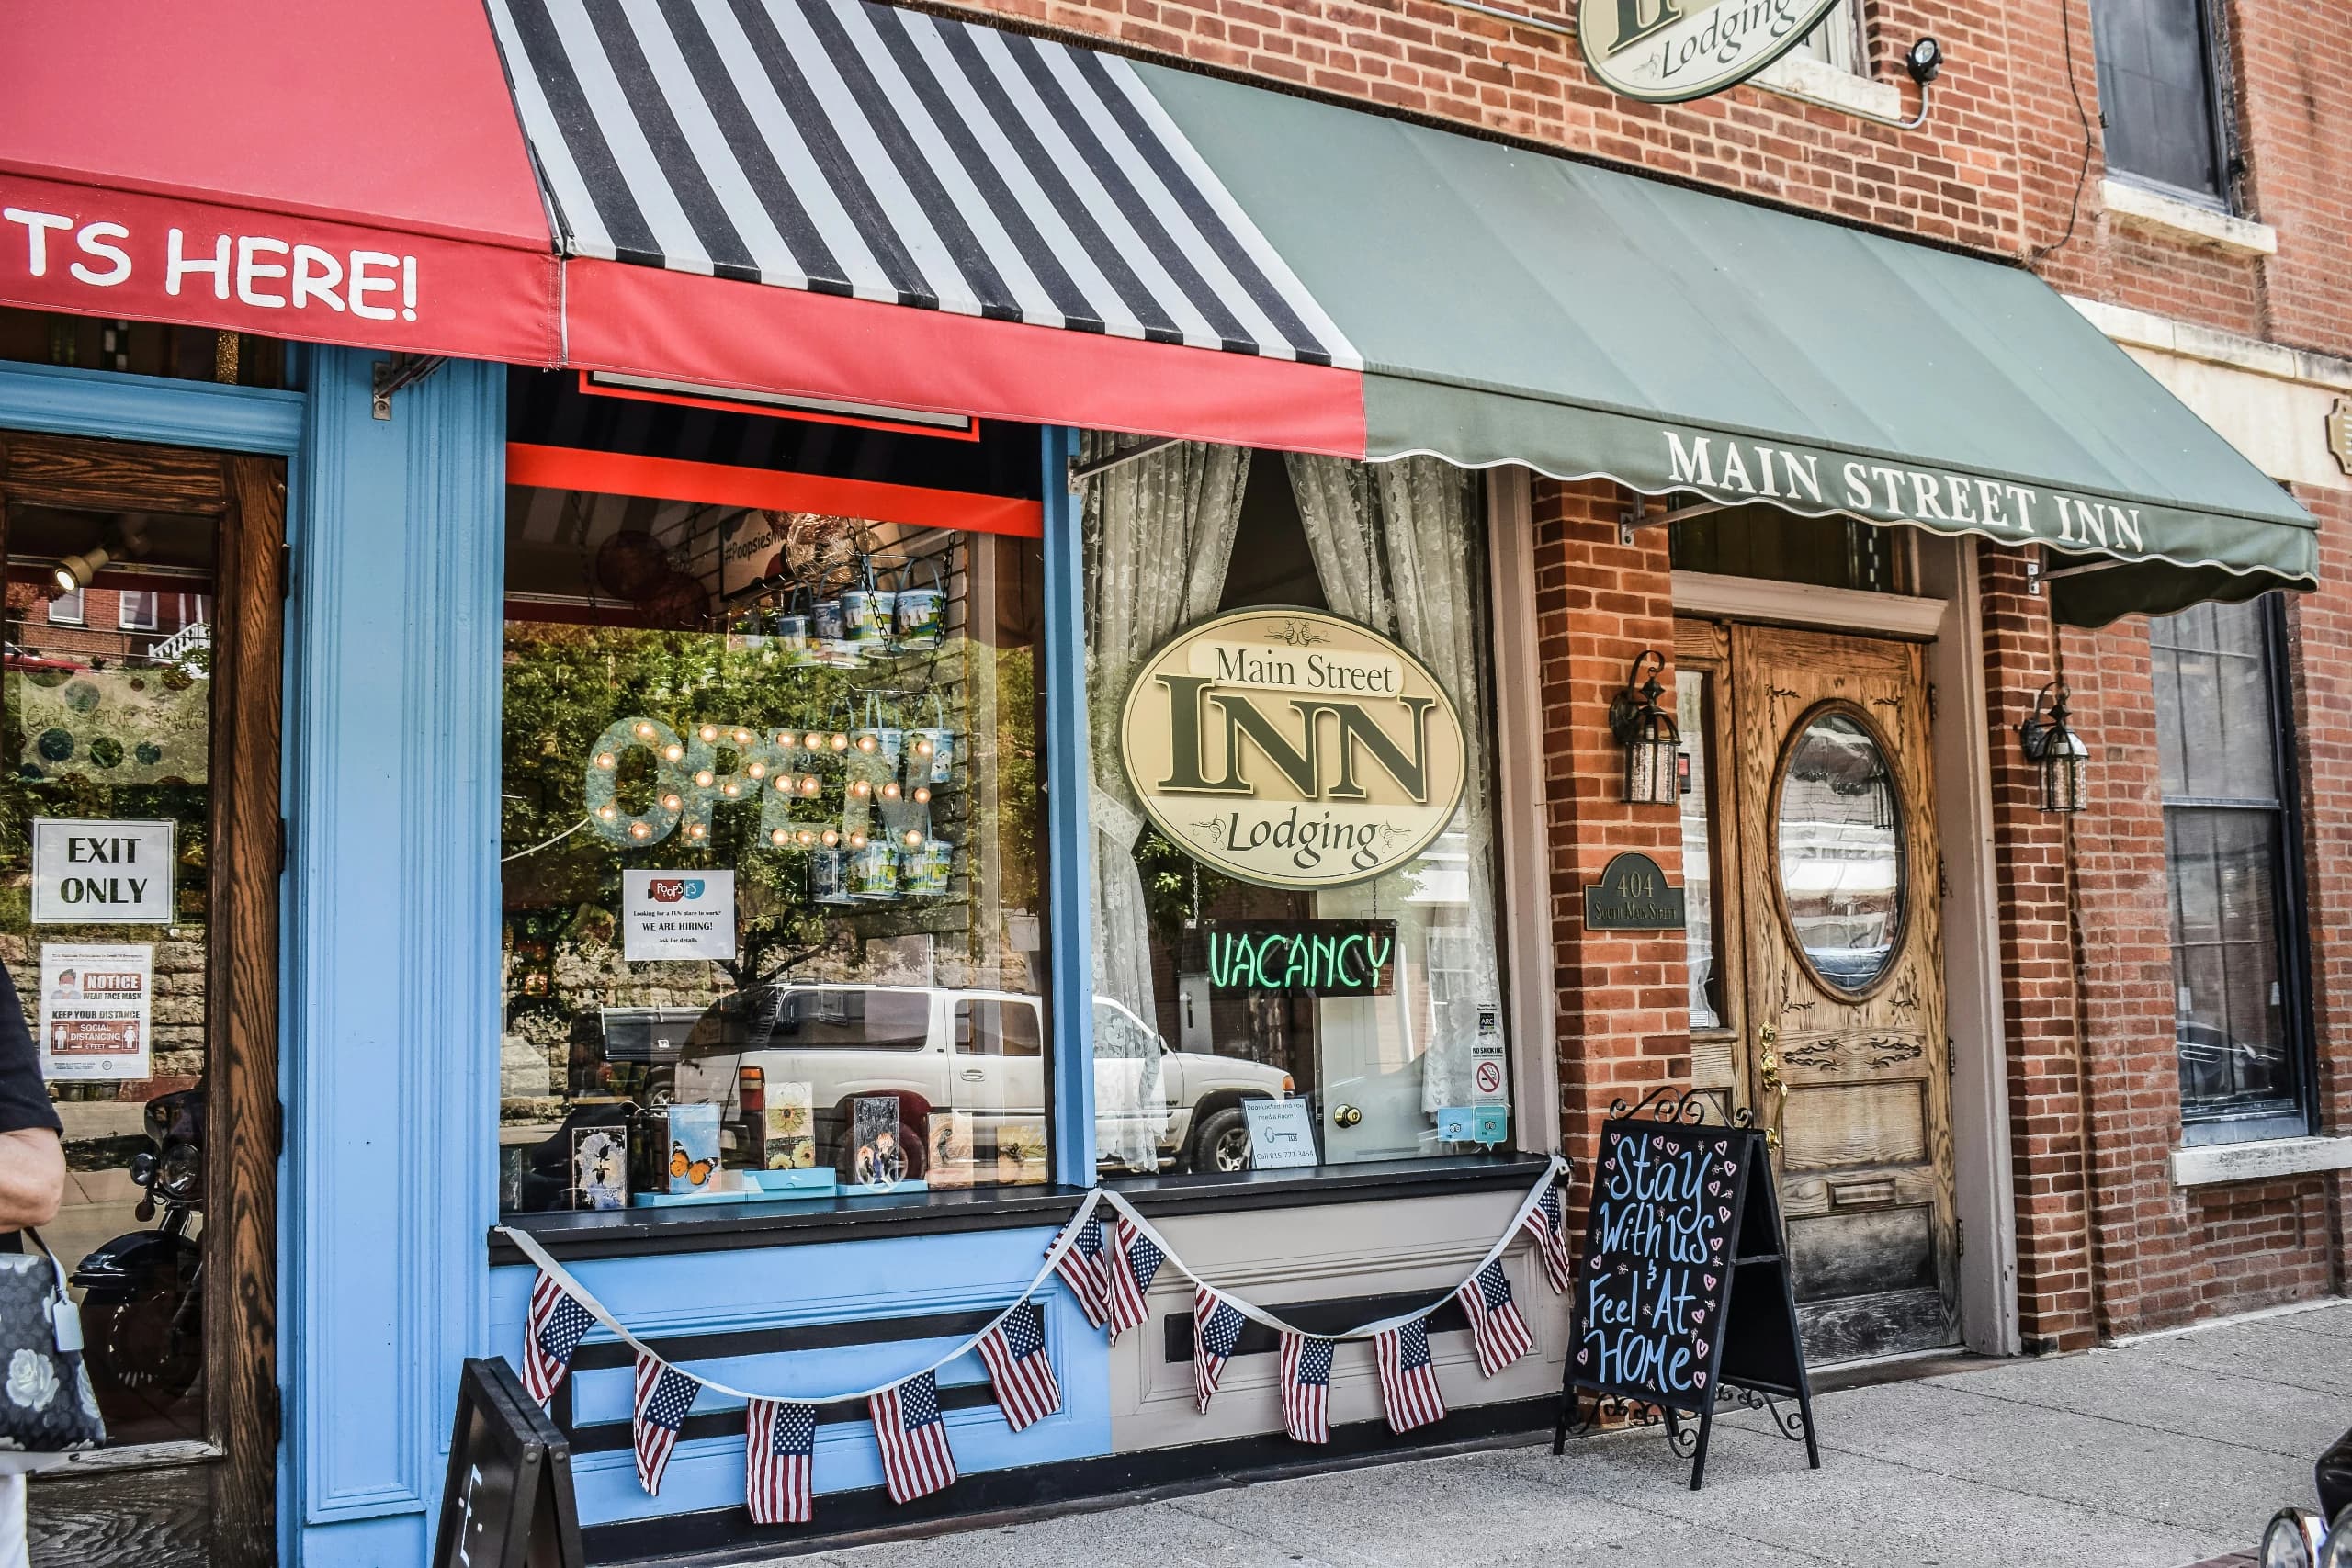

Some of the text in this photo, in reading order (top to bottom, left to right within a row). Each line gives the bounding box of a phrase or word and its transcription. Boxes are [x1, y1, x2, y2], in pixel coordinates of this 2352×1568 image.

[1662, 0, 1796, 79] Lodging
[3, 207, 418, 322] TS HERE!
[1663, 431, 2143, 552] MAIN STREET INN
[1215, 647, 1394, 694] Main Street
[1155, 674, 1436, 803] INN
[585, 716, 934, 852] OPEN
[68, 838, 141, 863] EXIT
[1227, 806, 1380, 870] Lodging
[60, 877, 148, 904] ONLY
[1617, 871, 1653, 897] 404
[642, 921, 713, 931] WE ARE HIRING!
[87, 975, 139, 989] NOTICE
[1210, 932, 1390, 988] VACANCY
[52, 1010, 141, 1020] KEEP YOUR DISTANCE
[83, 992, 141, 1000] WEAR FACE MASK
[70, 1032, 121, 1041] DISTANCING
[80, 1023, 111, 1032] SOCIAL
[1610, 1133, 1713, 1235] Stay
[1600, 1201, 1662, 1258] With
[1589, 1269, 1697, 1335] Feel At
